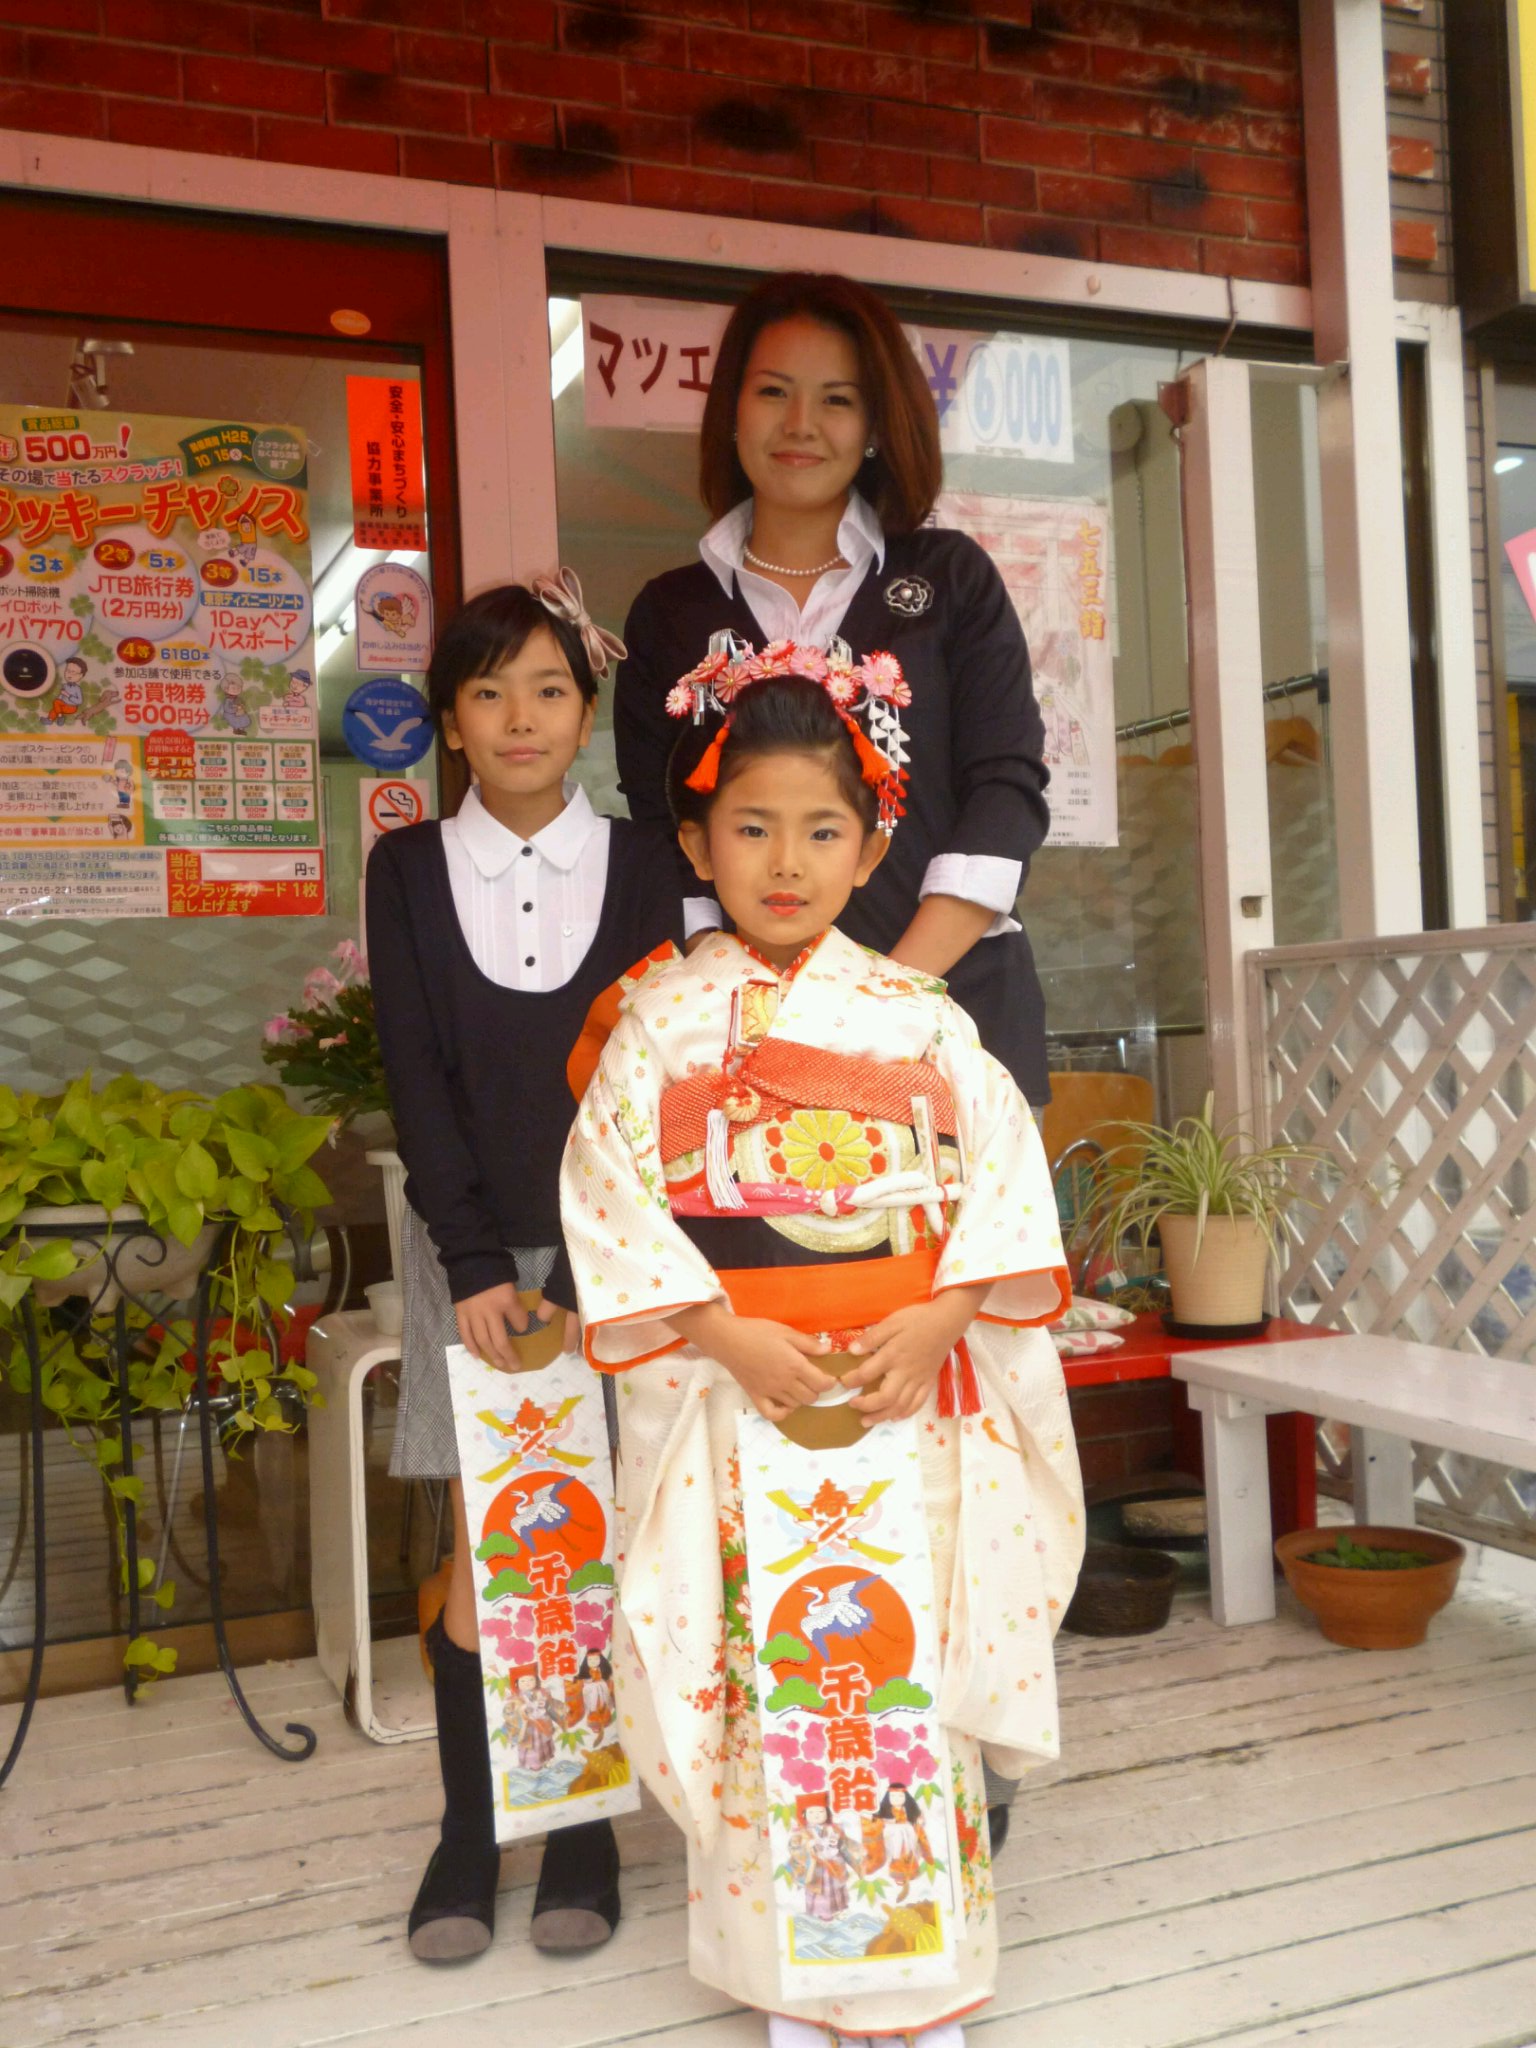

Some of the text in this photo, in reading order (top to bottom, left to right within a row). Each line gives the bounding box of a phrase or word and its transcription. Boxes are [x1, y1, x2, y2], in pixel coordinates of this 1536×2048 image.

[388, 385, 408, 519] 安全・安心まちづくり
[366, 441, 384, 518] 協力事業所
[88, 575, 195, 599] JTB旅行券
[0, 614, 84, 641] バ770
[123, 681, 206, 704] お買物券
[124, 703, 210, 726] 500円分
[169, 853, 199, 868] 当店
[170, 868, 199, 881] では
[171, 899, 252, 913] 差し上げます
[527, 1551, 580, 1682] 千歳飴
[818, 1662, 881, 1815] 千歳飴
